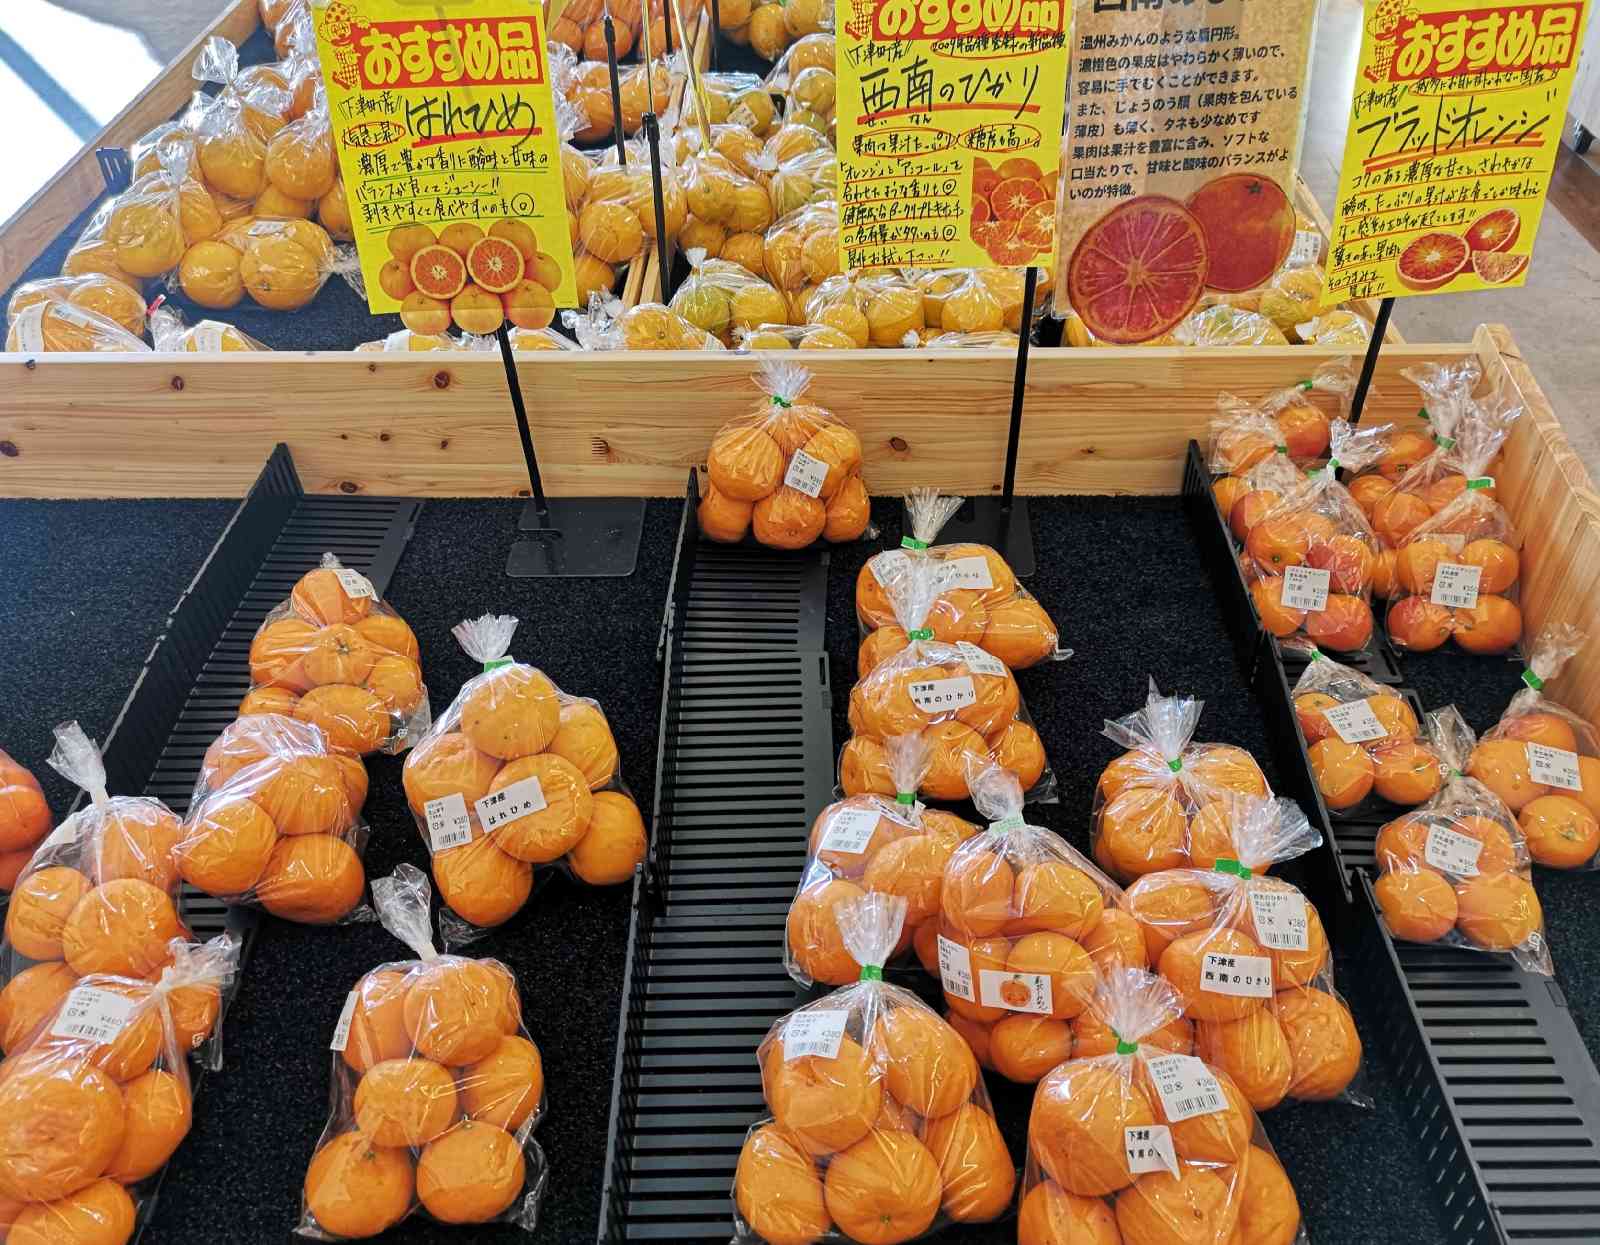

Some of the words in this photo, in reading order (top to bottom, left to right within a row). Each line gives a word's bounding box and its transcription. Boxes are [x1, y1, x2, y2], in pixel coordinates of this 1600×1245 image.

[360, 22, 539, 85] おすすめ品
[1397, 8, 1576, 77] おすすめ品
[405, 91, 535, 147] はれひめ
[860, 56, 1039, 119] 西南のひかり
[1357, 88, 1557, 157] ブラッドオレンジ
[488, 800, 532, 825] はれひめ
